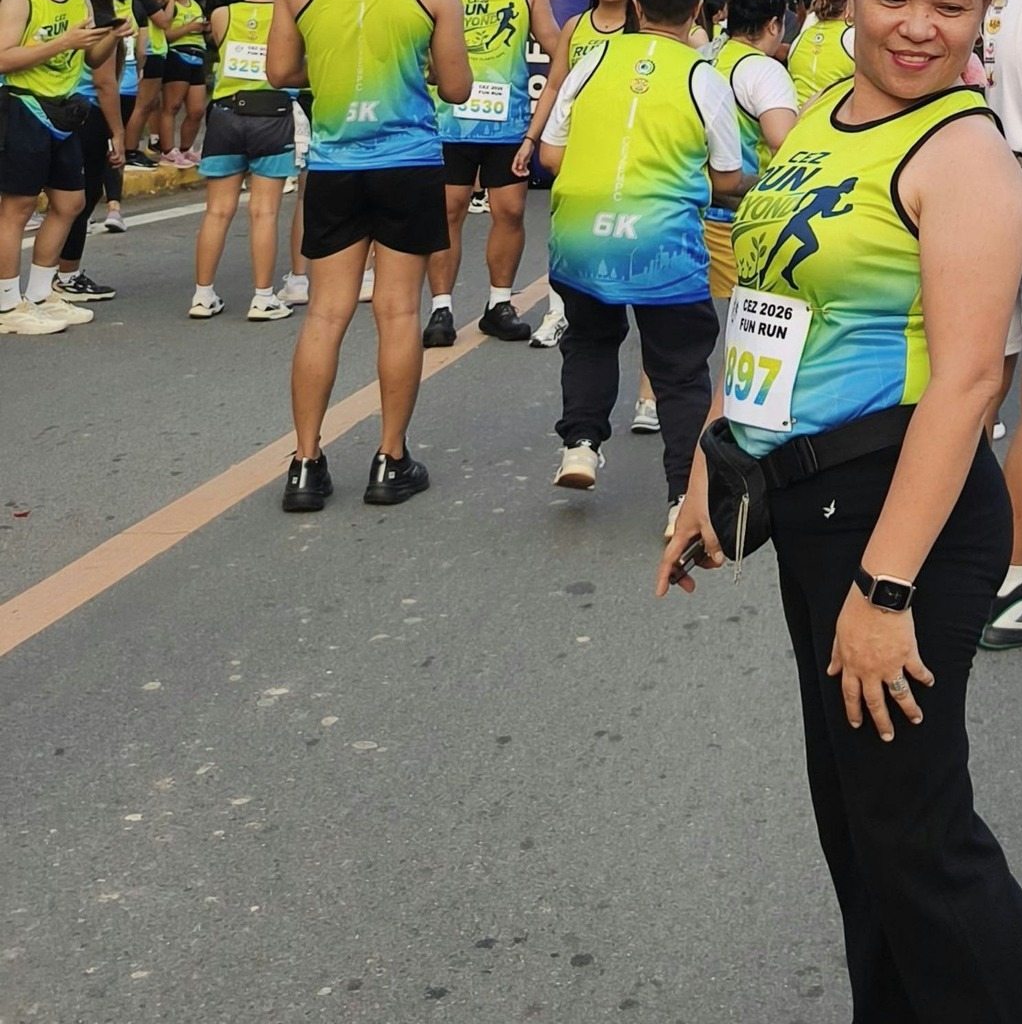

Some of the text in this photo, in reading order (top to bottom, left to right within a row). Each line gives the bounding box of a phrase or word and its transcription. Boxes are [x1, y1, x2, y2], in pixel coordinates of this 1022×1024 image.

[465, 3, 489, 16] UN
[464, 16, 499, 27] YOND
[228, 57, 267, 74] 325
[788, 151, 832, 164] CEZ
[591, 211, 642, 239] 6K
[743, 299, 794, 321] CEZ 2026
[739, 317, 788, 340] FUN RUN
